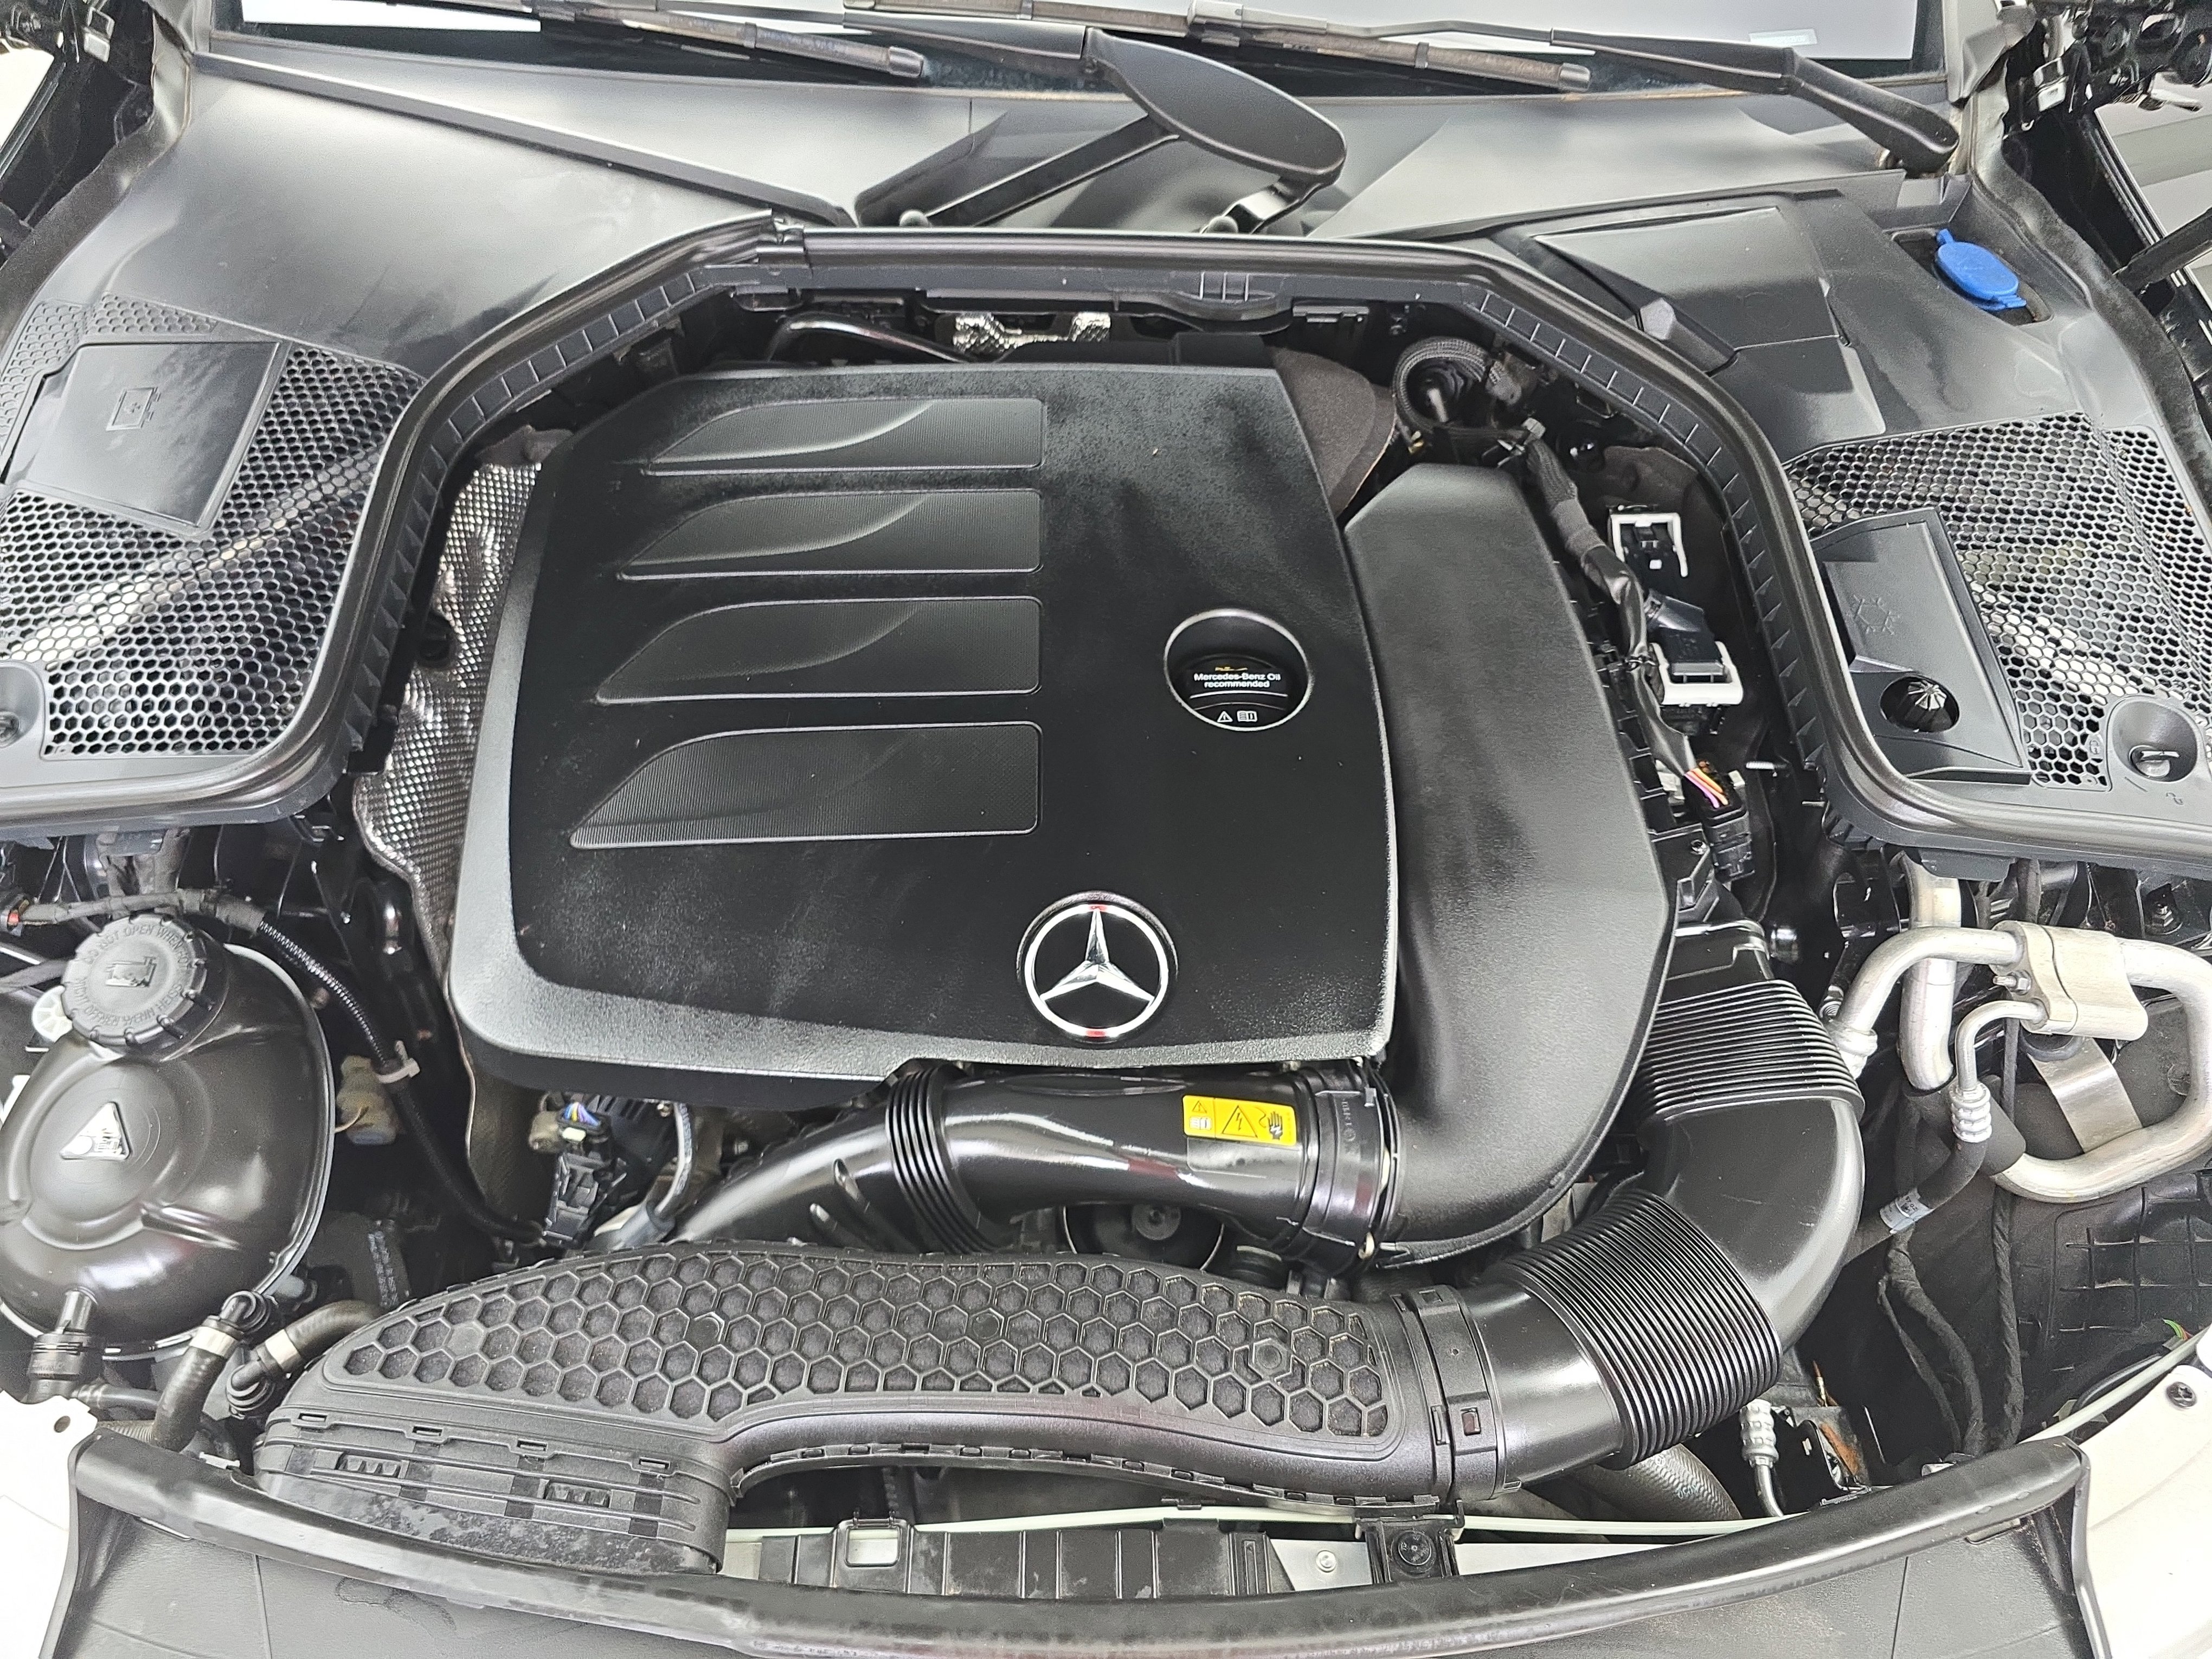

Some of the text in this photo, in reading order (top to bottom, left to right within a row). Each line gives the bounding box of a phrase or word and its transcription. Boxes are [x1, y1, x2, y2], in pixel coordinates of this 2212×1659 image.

[1194, 673, 1266, 681] Mercedes-Benz
[124, 924, 155, 937] OPEN
[156, 926, 184, 950] WHEN
[123, 1008, 156, 1026] WENN
[156, 983, 184, 1012] HEISS
